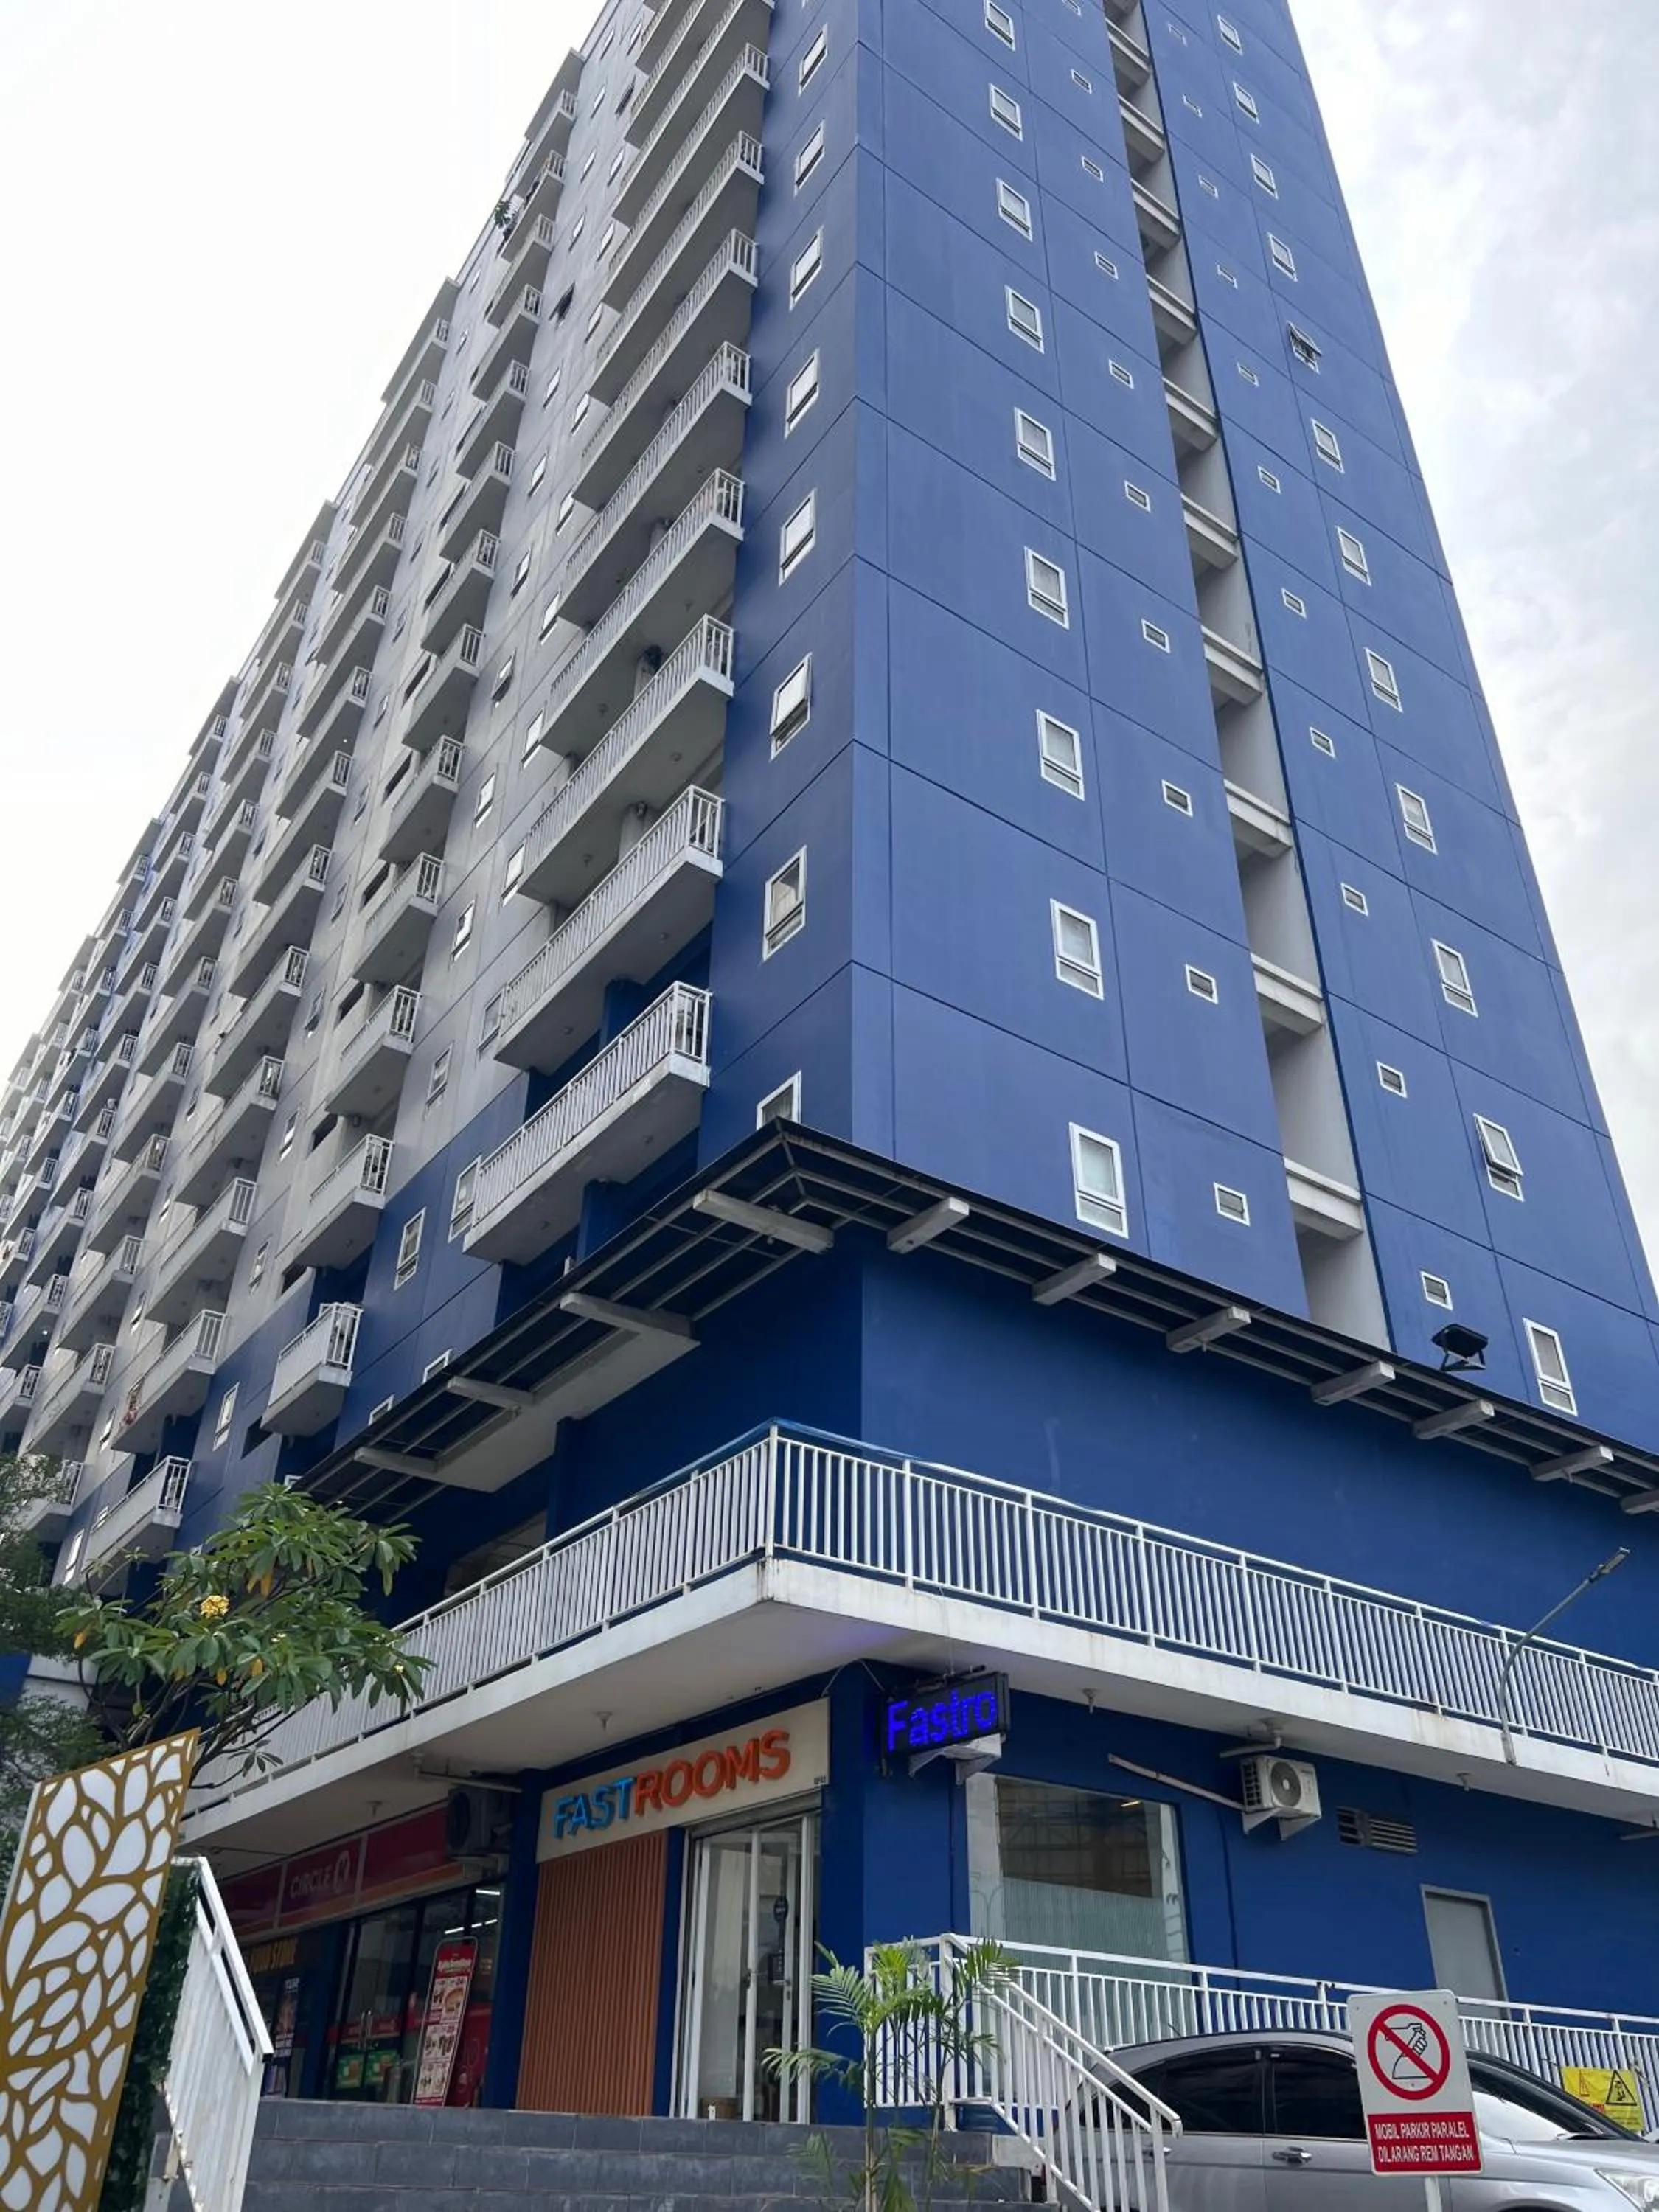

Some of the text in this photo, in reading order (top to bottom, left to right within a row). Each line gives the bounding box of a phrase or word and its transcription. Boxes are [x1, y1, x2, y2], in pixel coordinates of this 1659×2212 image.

[888, 1688, 998, 1753] Fastro
[554, 1729, 791, 1840] FASTROOMS
[291, 1863, 332, 1899] CIRCLE
[1374, 2121, 1470, 2139] MOBIL PARKIR PARALEL
[1378, 2143, 1474, 2163] DILARANG REM TANGAN
